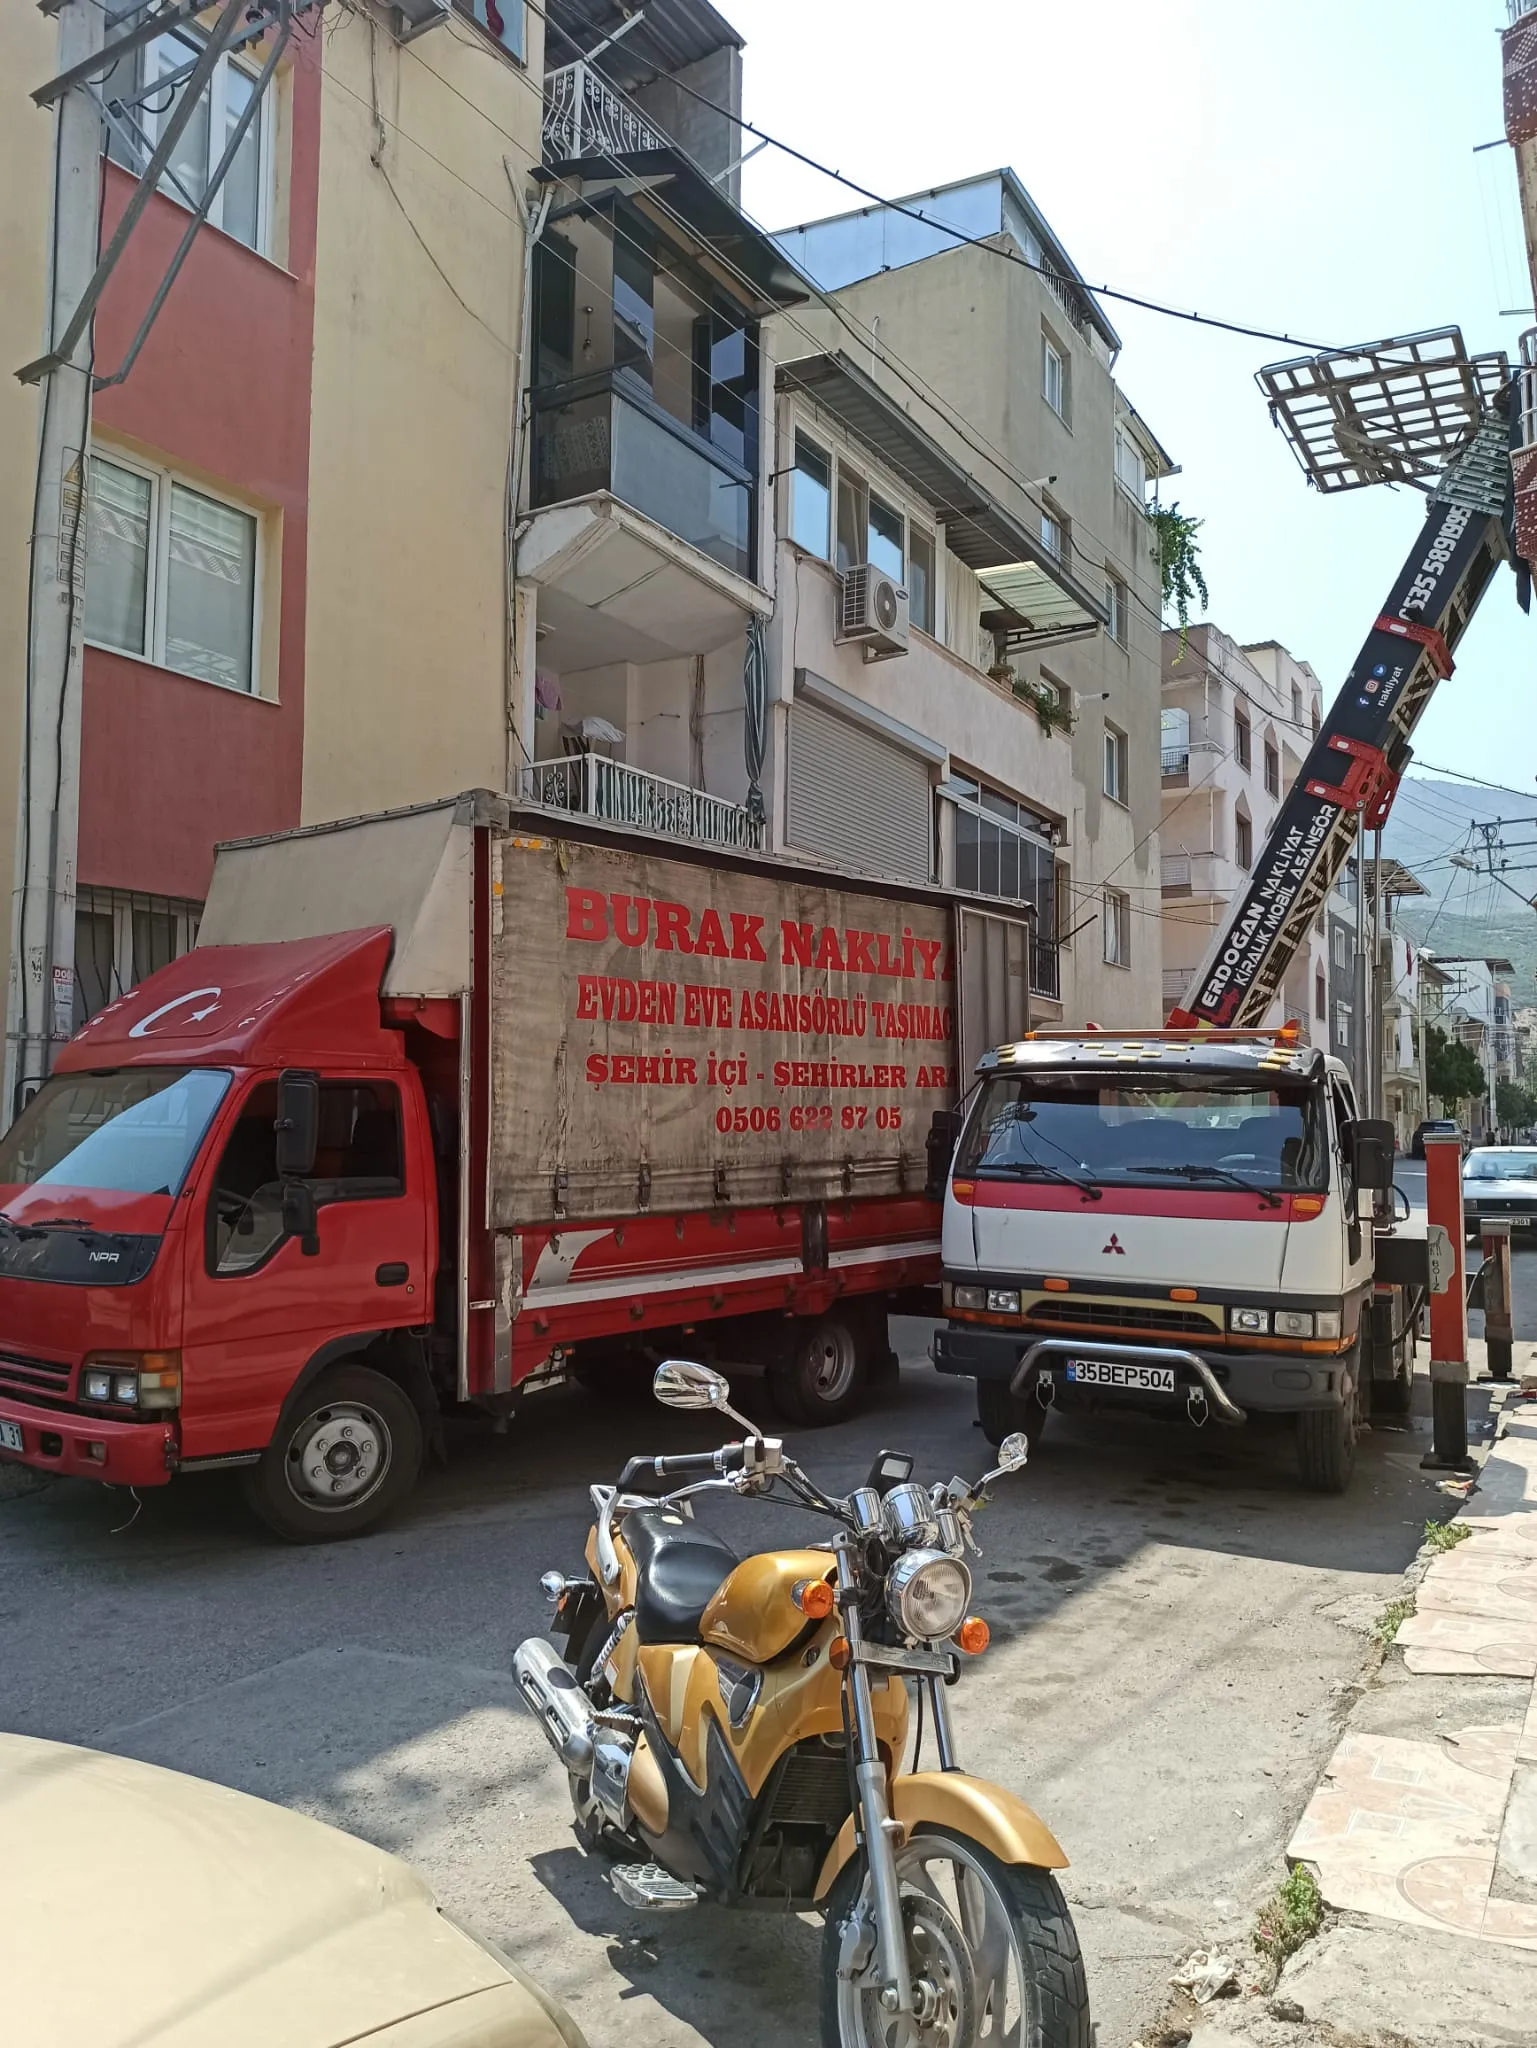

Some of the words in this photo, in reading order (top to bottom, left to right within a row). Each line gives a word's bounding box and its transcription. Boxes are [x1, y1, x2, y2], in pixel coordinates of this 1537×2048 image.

[1421, 505, 1473, 576] 5891995
[1377, 666, 1404, 707] nakliyat
[1201, 902, 1266, 1008] ERDOĞAN
[1259, 825, 1305, 900] NAKLİYAT
[1233, 928, 1272, 986] KİRALIK
[1264, 885, 1296, 930] MOBİL
[1290, 804, 1337, 881] ASANSÖR
[565, 886, 767, 962] BURAK
[576, 974, 677, 1025] EVDEN
[683, 984, 733, 1028] EVE
[739, 988, 867, 1037] ASANSÖRLÜ
[585, 1048, 698, 1092] ŞEHİR
[706, 1050, 748, 1095] İÇİ
[773, 1055, 907, 1095] ŞEHİRLER
[715, 1106, 782, 1134] 0506
[789, 1105, 833, 1132] 622
[841, 1105, 868, 1131] 87
[875, 1105, 902, 1131] 05
[88, 1251, 120, 1263] NPR
[1076, 1361, 1174, 1390] 35BEP504
